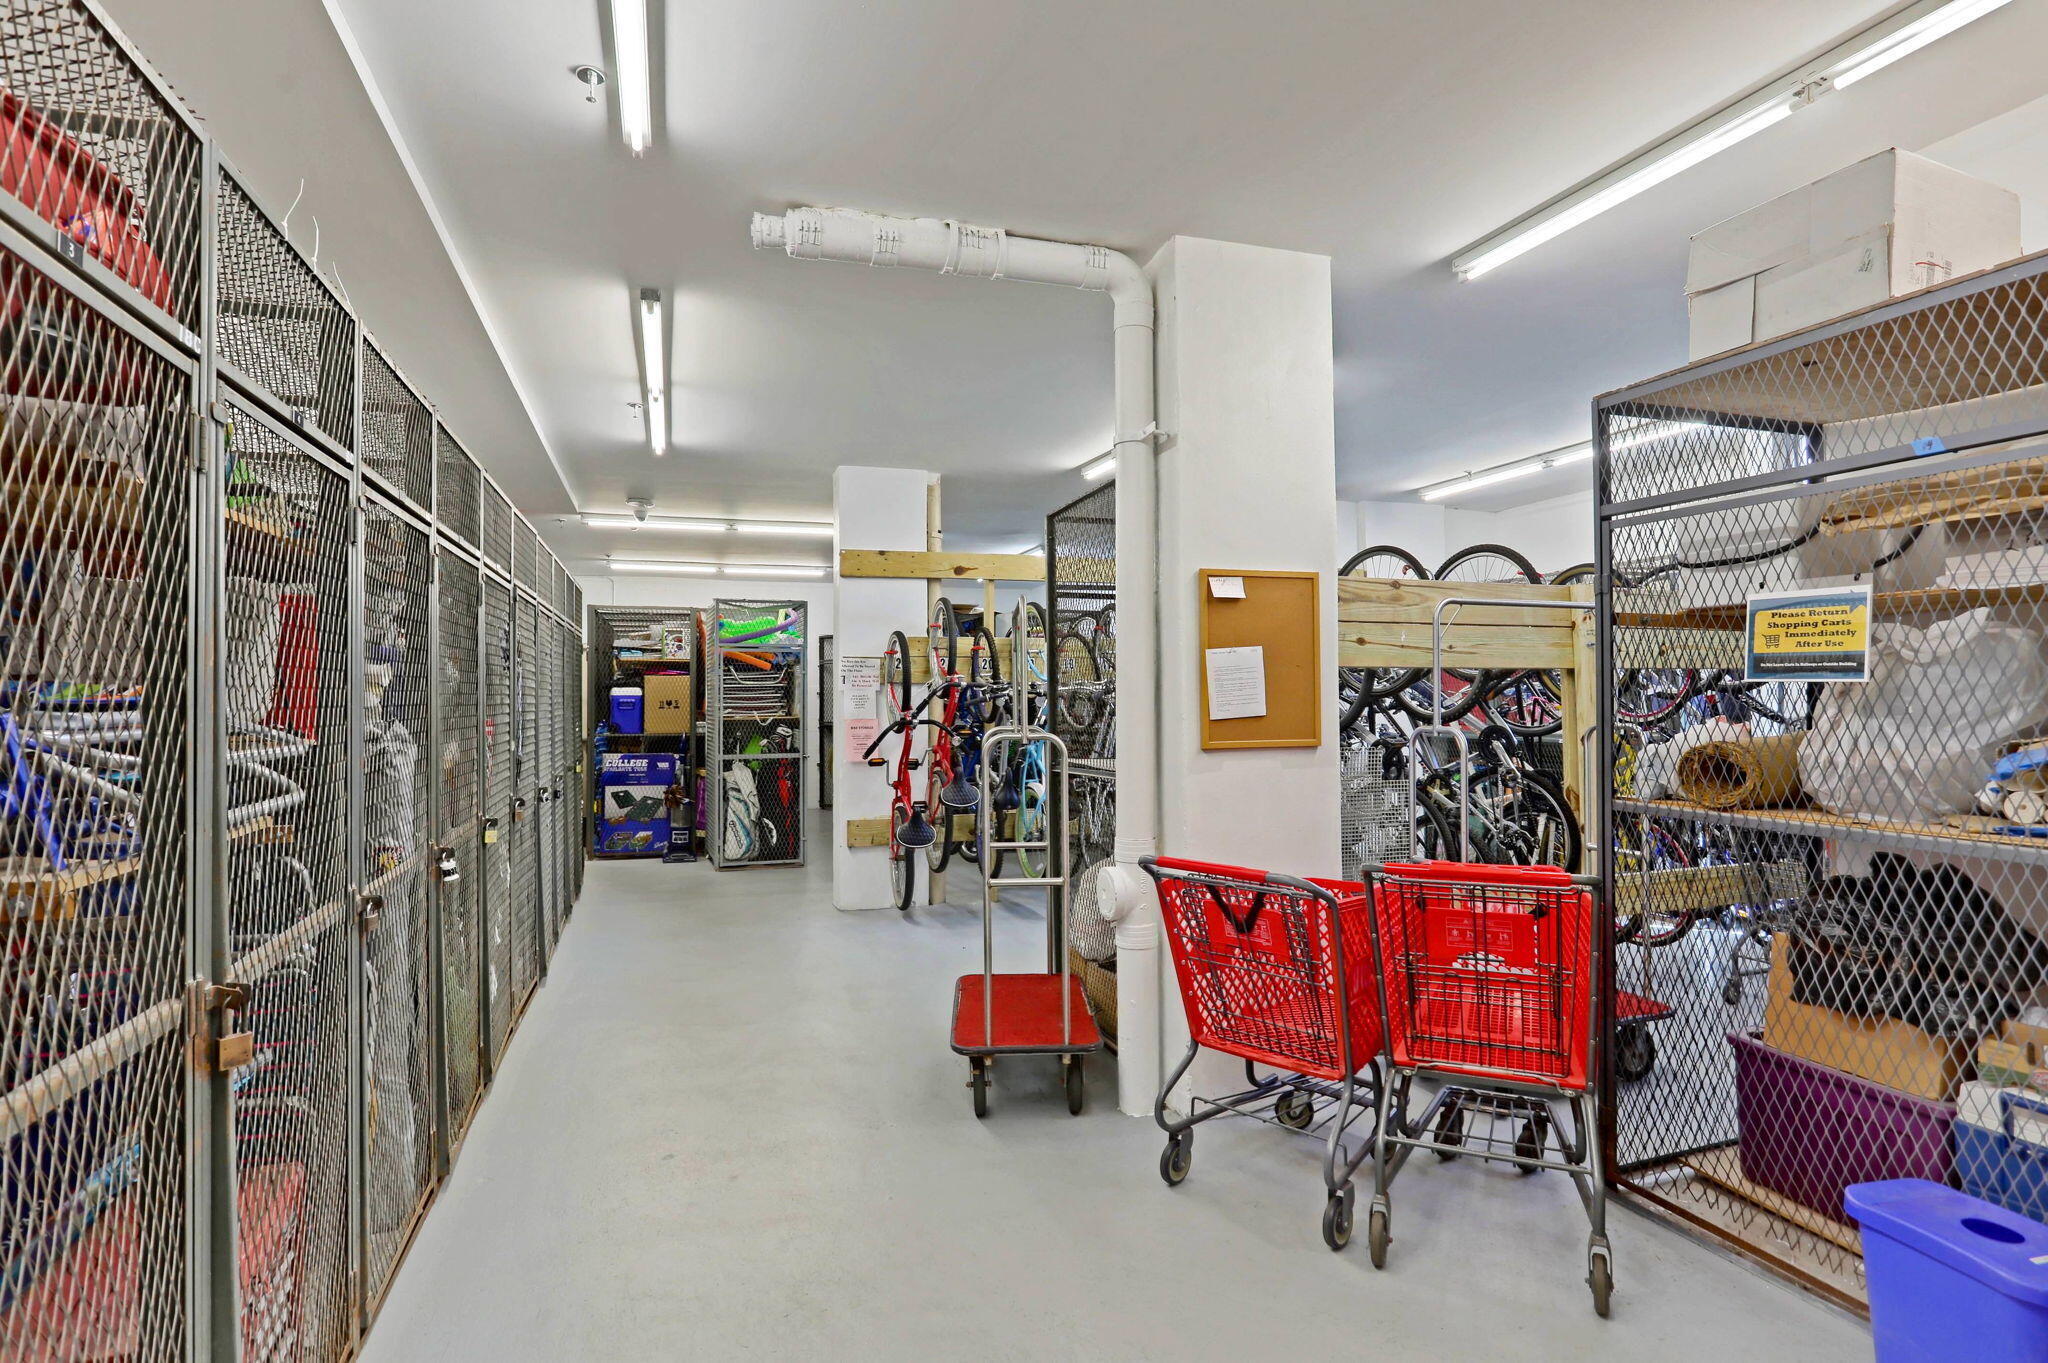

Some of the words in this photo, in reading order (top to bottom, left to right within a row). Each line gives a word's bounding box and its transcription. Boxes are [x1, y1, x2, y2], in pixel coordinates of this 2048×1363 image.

[69, 243, 75, 258] 3
[1771, 610, 1806, 618] Please
[1808, 609, 1848, 617] Return
[1767, 620, 1819, 629] Shopping
[1821, 618, 1852, 626] Carts
[1785, 628, 1857, 638] Immediately
[1795, 640, 1822, 648] After
[606, 759, 649, 767] COLLEGE
